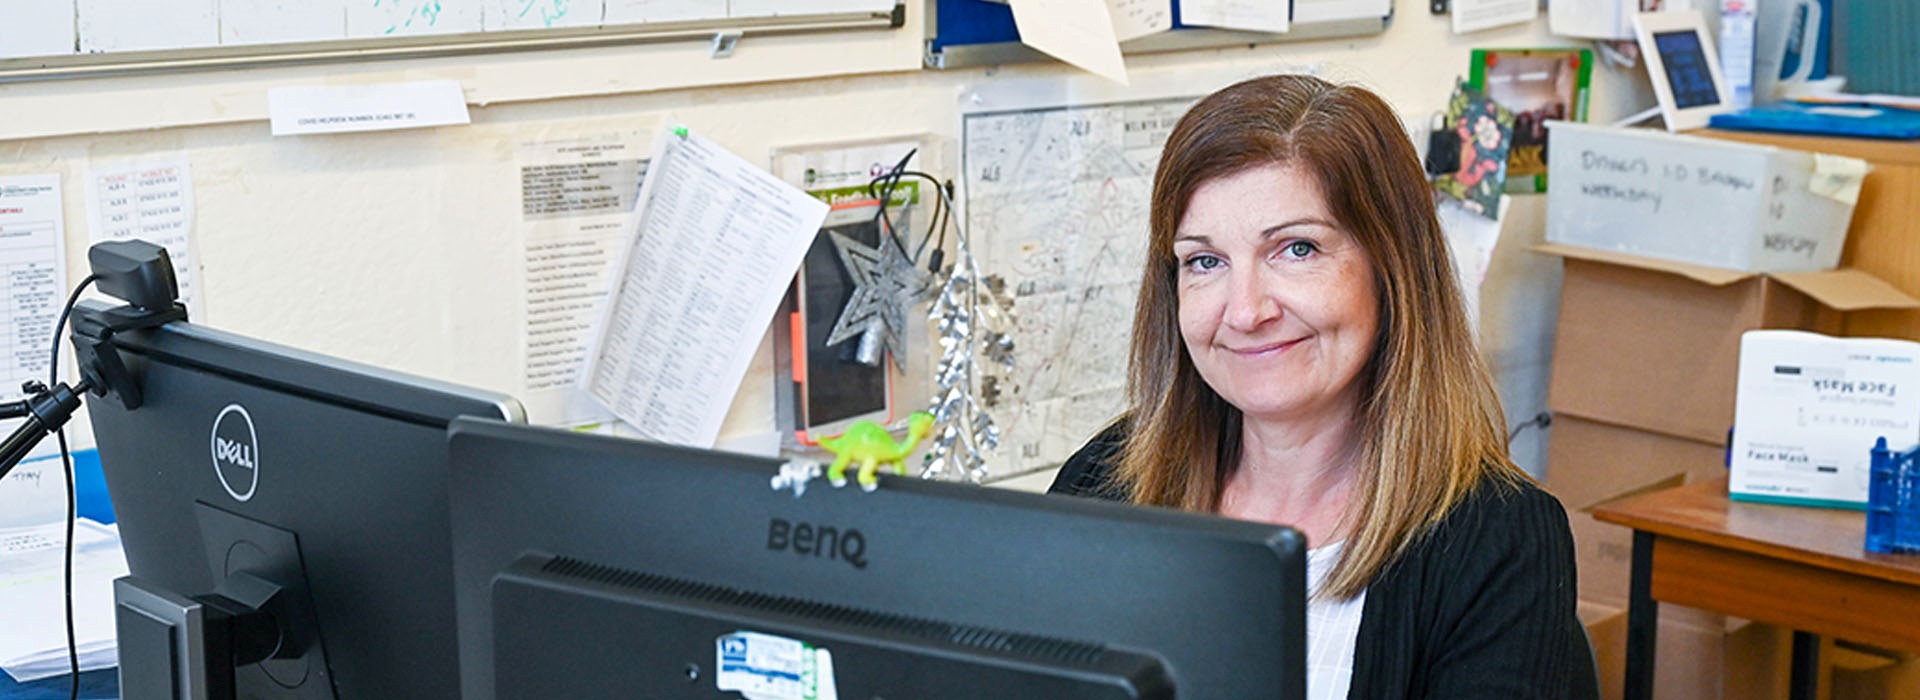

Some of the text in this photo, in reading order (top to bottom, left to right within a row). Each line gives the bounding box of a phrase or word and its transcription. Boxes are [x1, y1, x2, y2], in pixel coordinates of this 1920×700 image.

[1813, 379, 1897, 397] Face Mask
[217, 437, 253, 469] DELL
[1747, 450, 1810, 463] Face Mask
[767, 517, 869, 571] BenQ
